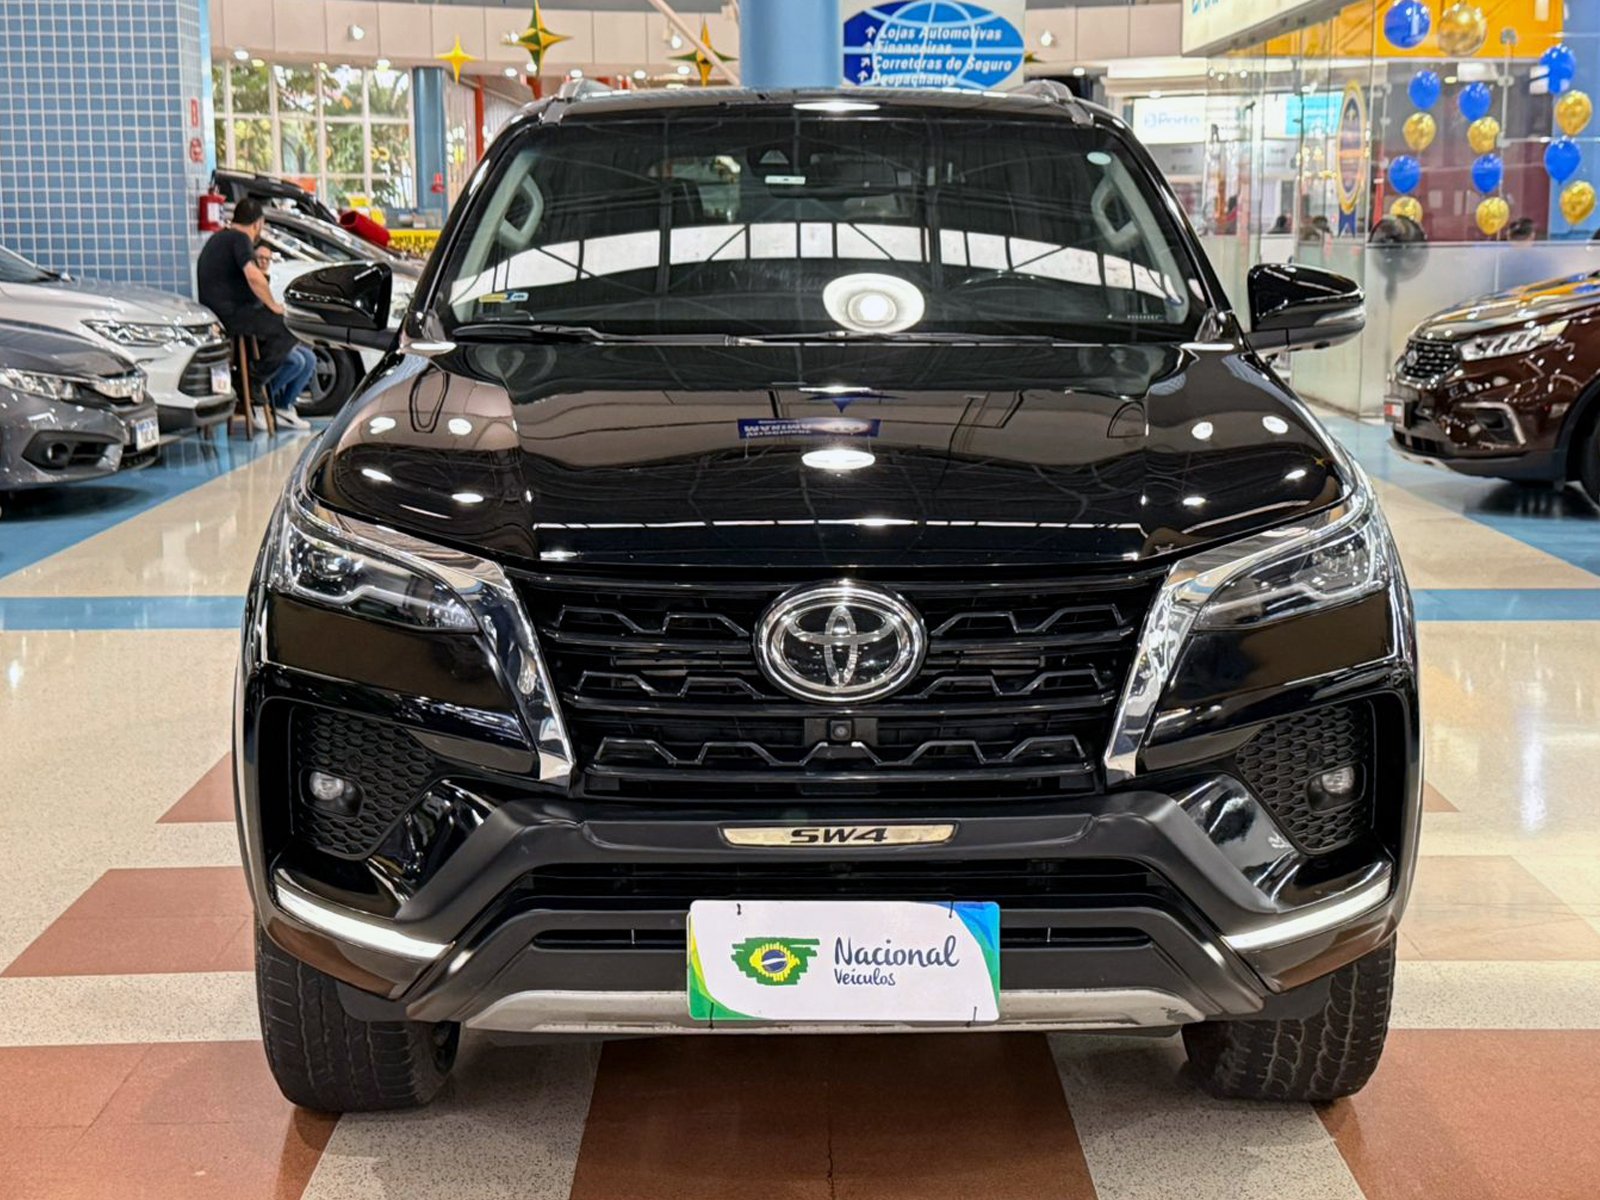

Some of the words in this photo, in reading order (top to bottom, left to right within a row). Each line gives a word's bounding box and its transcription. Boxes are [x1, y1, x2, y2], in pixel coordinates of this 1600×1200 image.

[880, 24, 916, 42] Lojas
[919, 25, 1002, 41] Automotivas
[877, 40, 952, 54] Financeiras
[874, 55, 943, 71] Corretoras
[946, 55, 963, 71] de
[966, 55, 1012, 74] Seguro
[872, 71, 956, 87] Despachante
[790, 827, 888, 844] SW4
[834, 935, 960, 968] Nacional
[834, 968, 897, 987] Veículos
